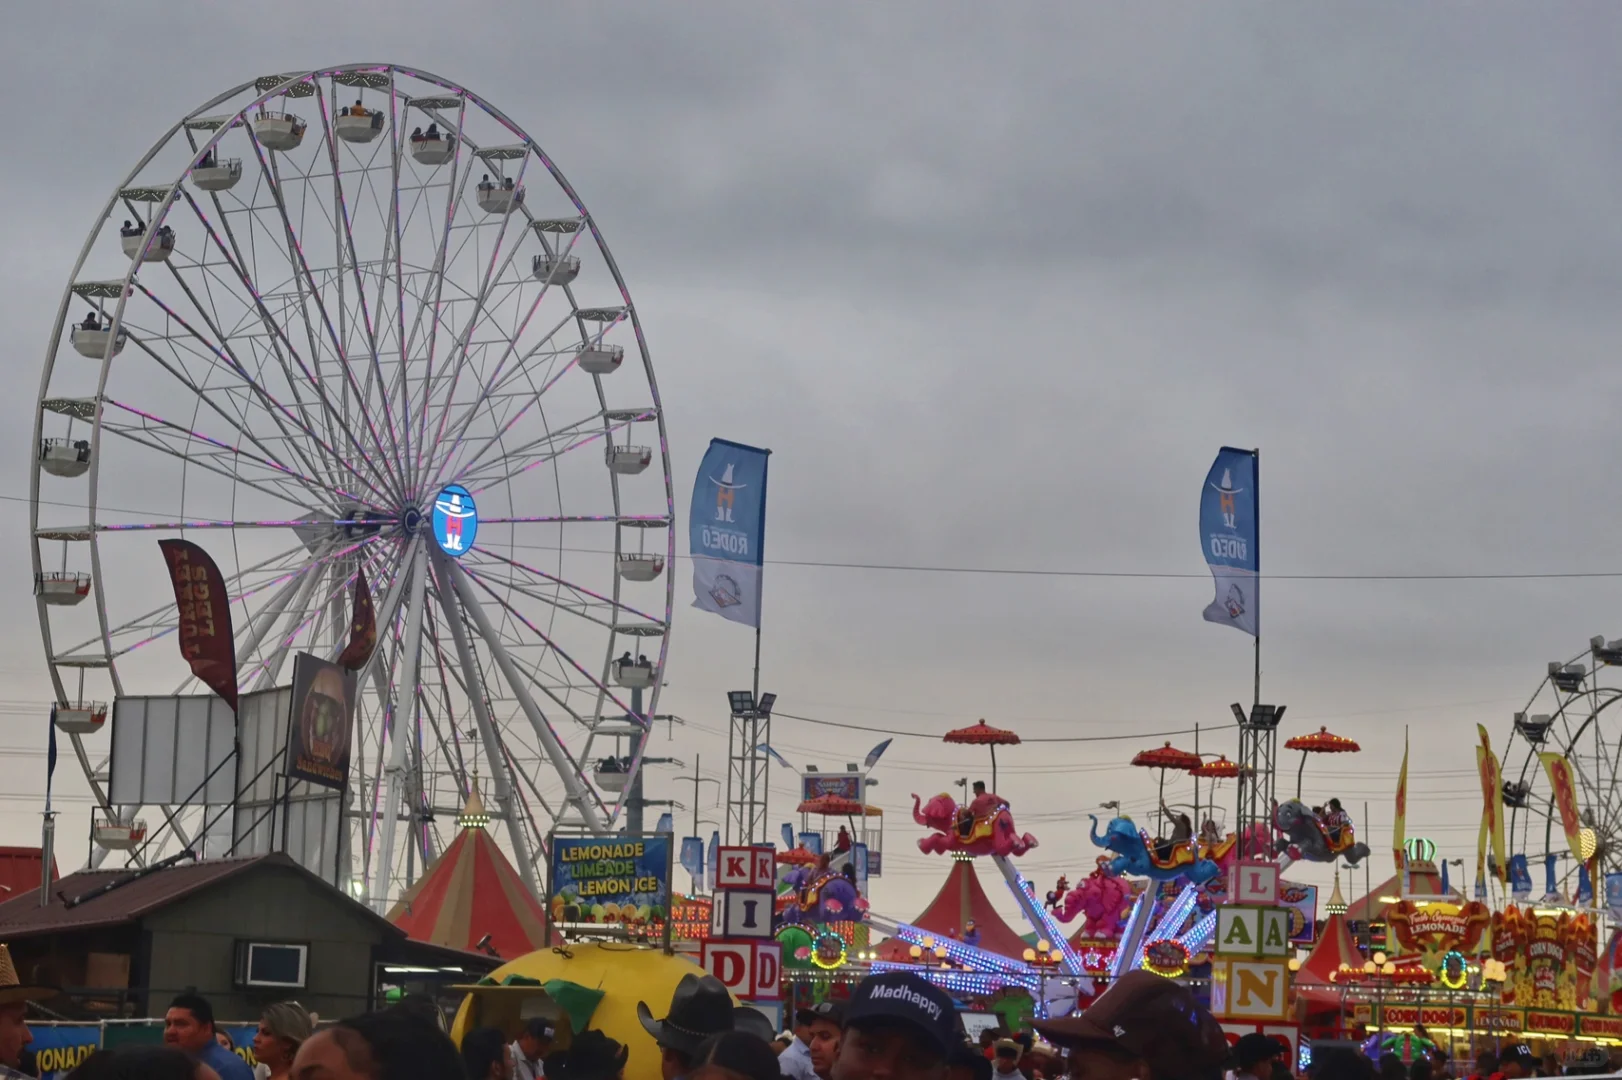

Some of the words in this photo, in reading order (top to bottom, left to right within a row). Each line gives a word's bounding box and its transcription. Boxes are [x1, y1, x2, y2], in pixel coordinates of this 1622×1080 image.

[191, 566, 214, 636] LEGS
[562, 843, 644, 862] LEMONADE
[571, 860, 635, 878] LIMEADE
[726, 857, 747, 877] K
[578, 879, 631, 896] LEMON
[634, 876, 657, 892] ICE
[1223, 915, 1252, 945] A
[1409, 922, 1467, 936] LEMONADE
[1237, 969, 1278, 1007] N
[869, 984, 942, 1021] Madhappy
